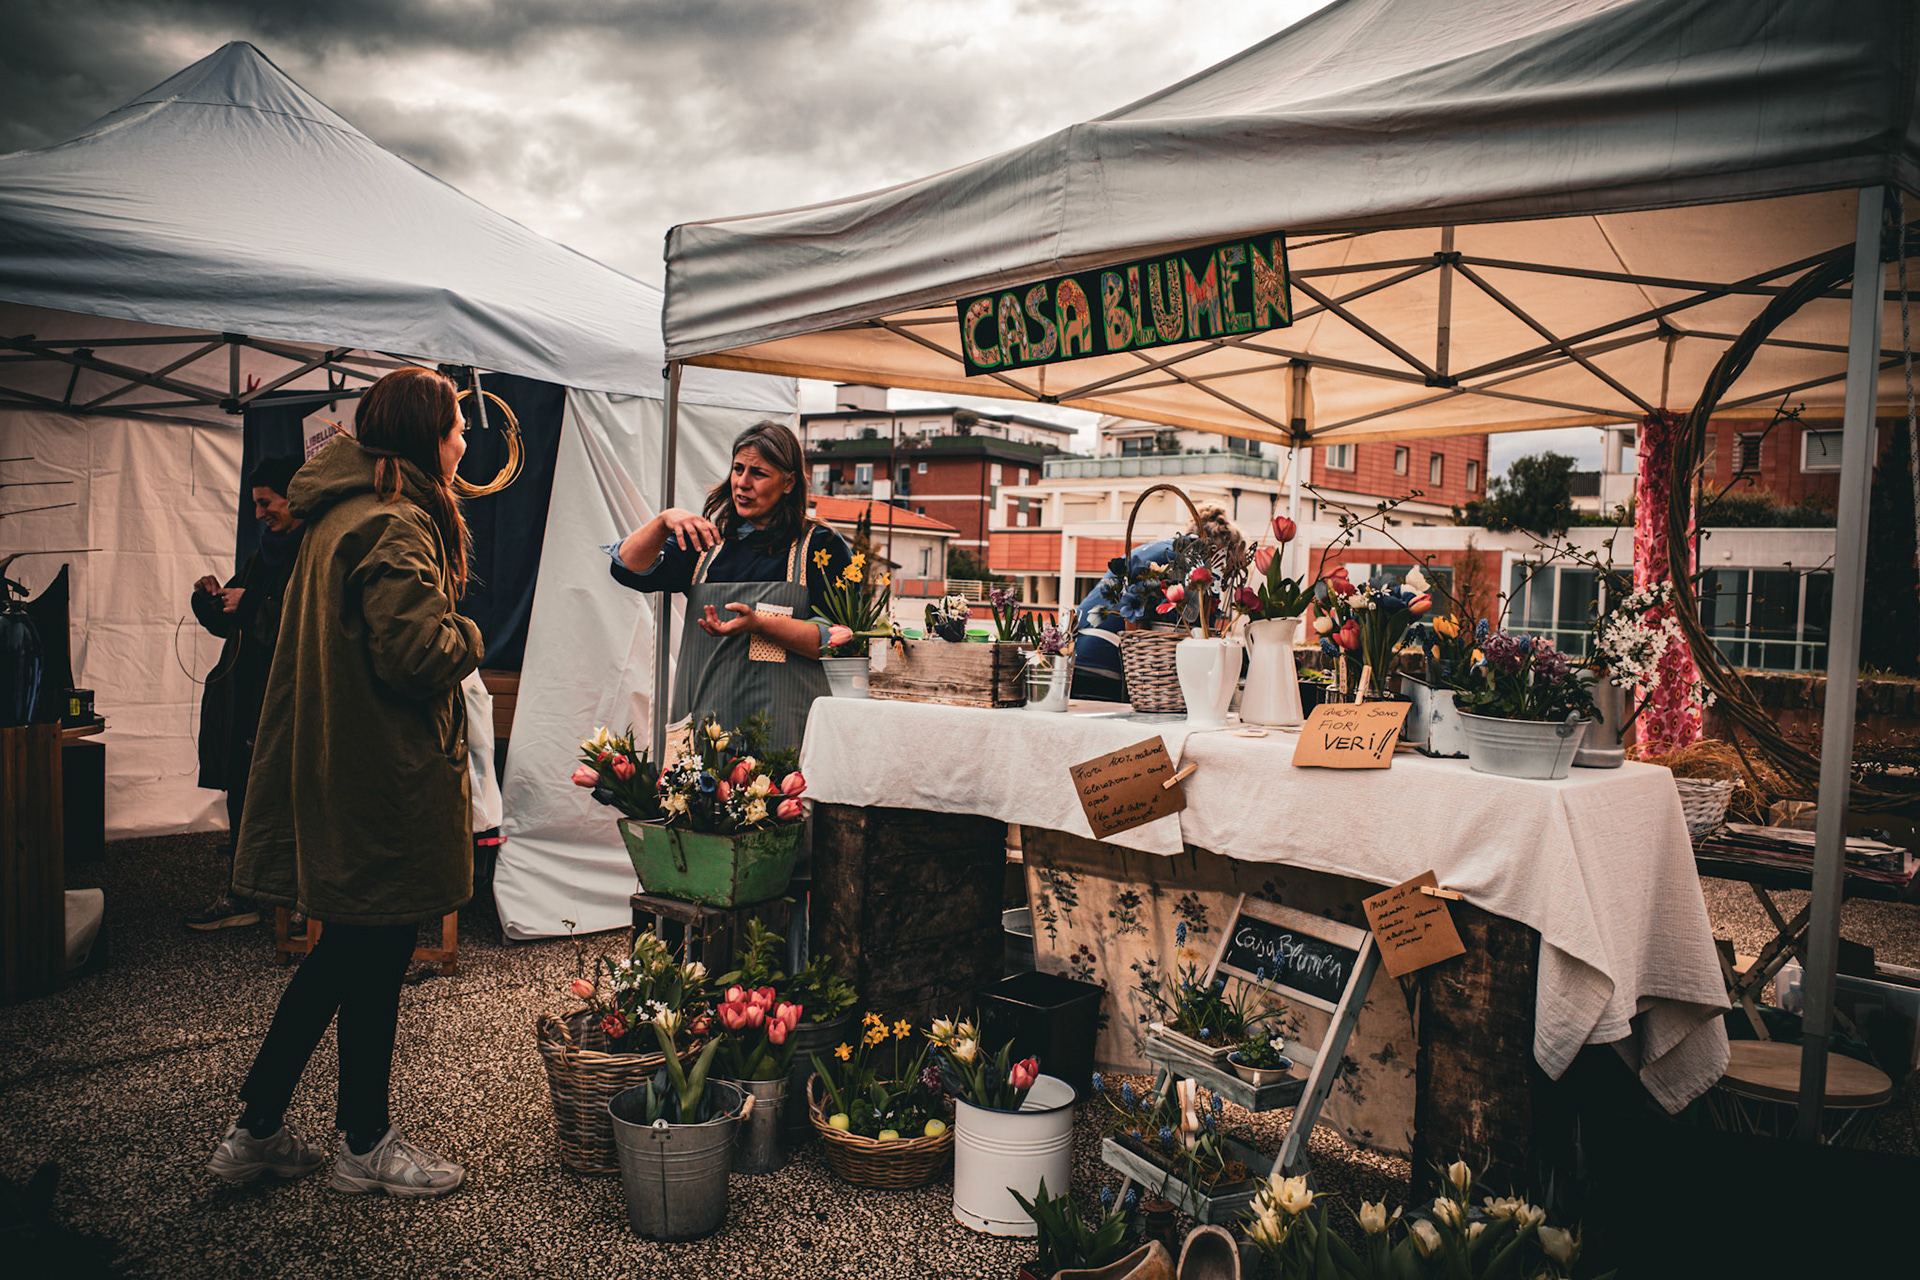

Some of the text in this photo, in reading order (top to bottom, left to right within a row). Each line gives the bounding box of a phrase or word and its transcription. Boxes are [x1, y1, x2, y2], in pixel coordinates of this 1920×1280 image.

[963, 237, 1290, 368] CASA BLUMEN
[1318, 719, 1360, 732] FIORI
[1367, 707, 1399, 718] SONO
[1235, 927, 1342, 990] Casa Blumen
